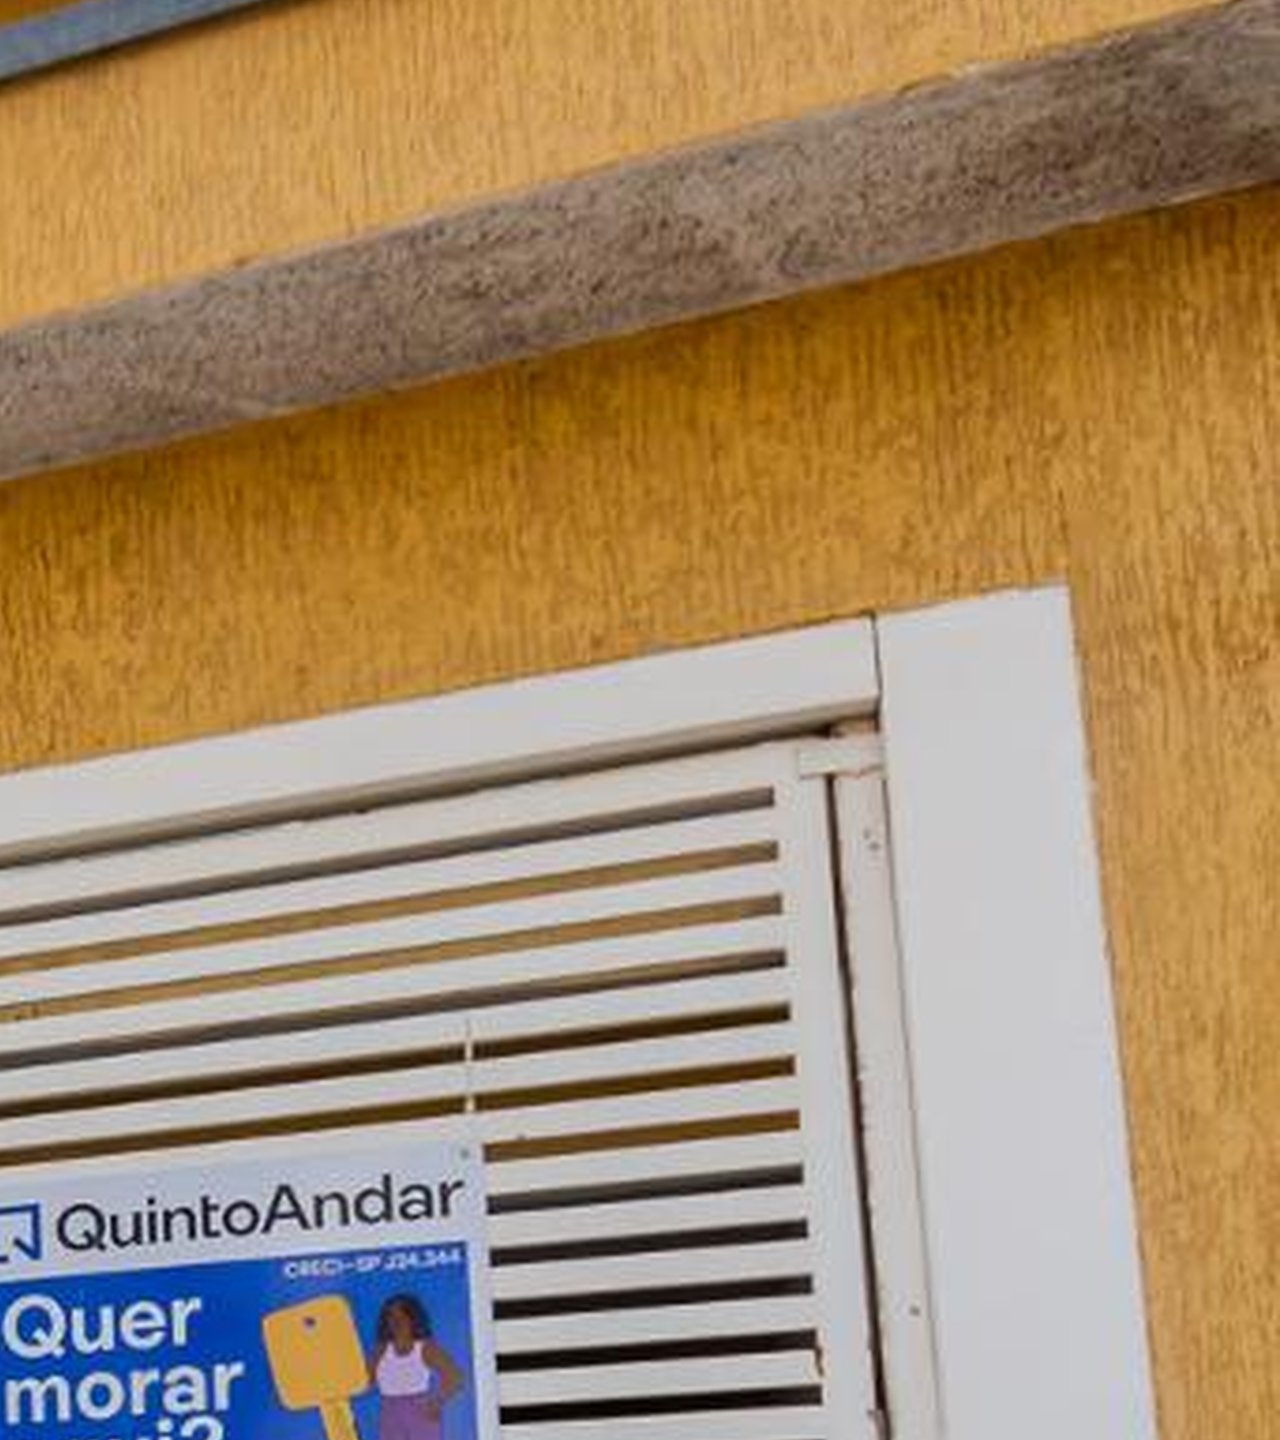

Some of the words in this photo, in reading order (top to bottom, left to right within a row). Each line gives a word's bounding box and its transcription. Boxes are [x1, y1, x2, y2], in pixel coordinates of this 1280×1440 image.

[56, 1174, 465, 1252] QuintoAndar
[2, 1293, 203, 1360] Quer
[6, 1361, 246, 1426] morar
